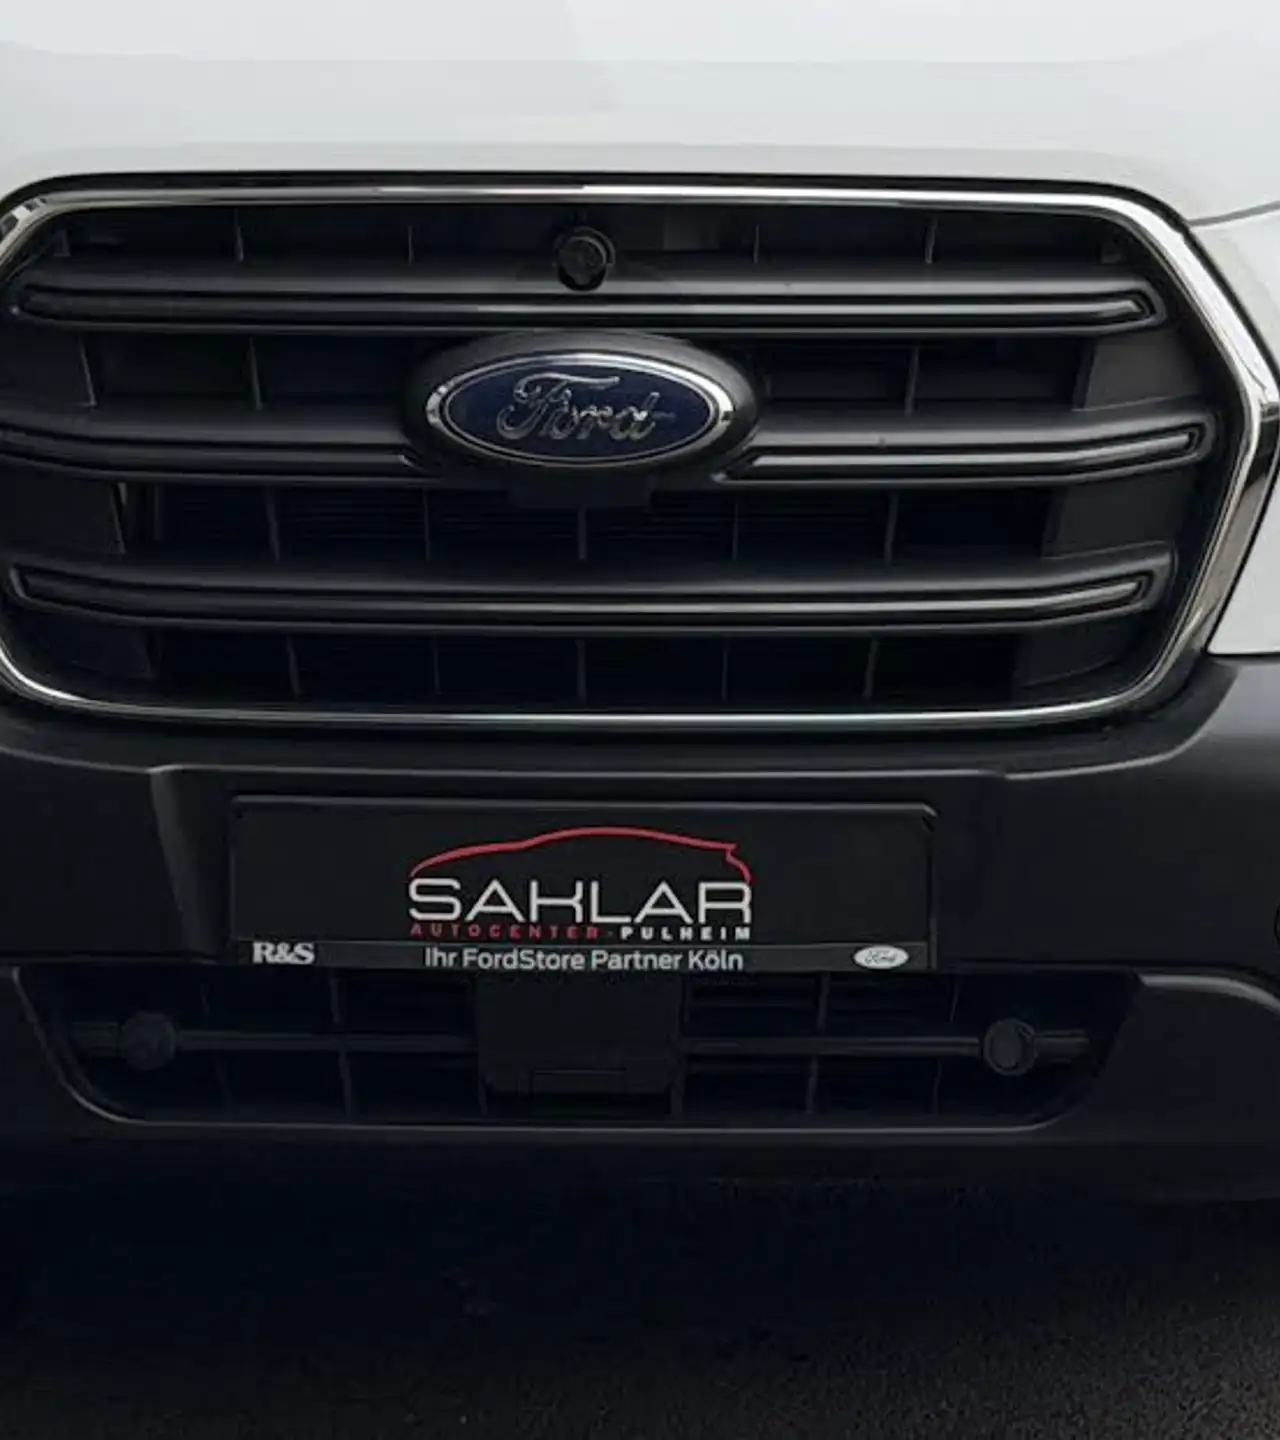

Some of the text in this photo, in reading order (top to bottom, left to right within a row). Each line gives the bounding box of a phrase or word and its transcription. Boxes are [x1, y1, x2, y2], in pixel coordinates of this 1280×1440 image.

[497, 372, 675, 440] Ford
[408, 877, 752, 924] SAHLAR
[410, 923, 751, 941] AUTOCENTER PULHEIM
[253, 942, 315, 965] R&S
[425, 947, 744, 970] Ihr FordStore Partner Köln
